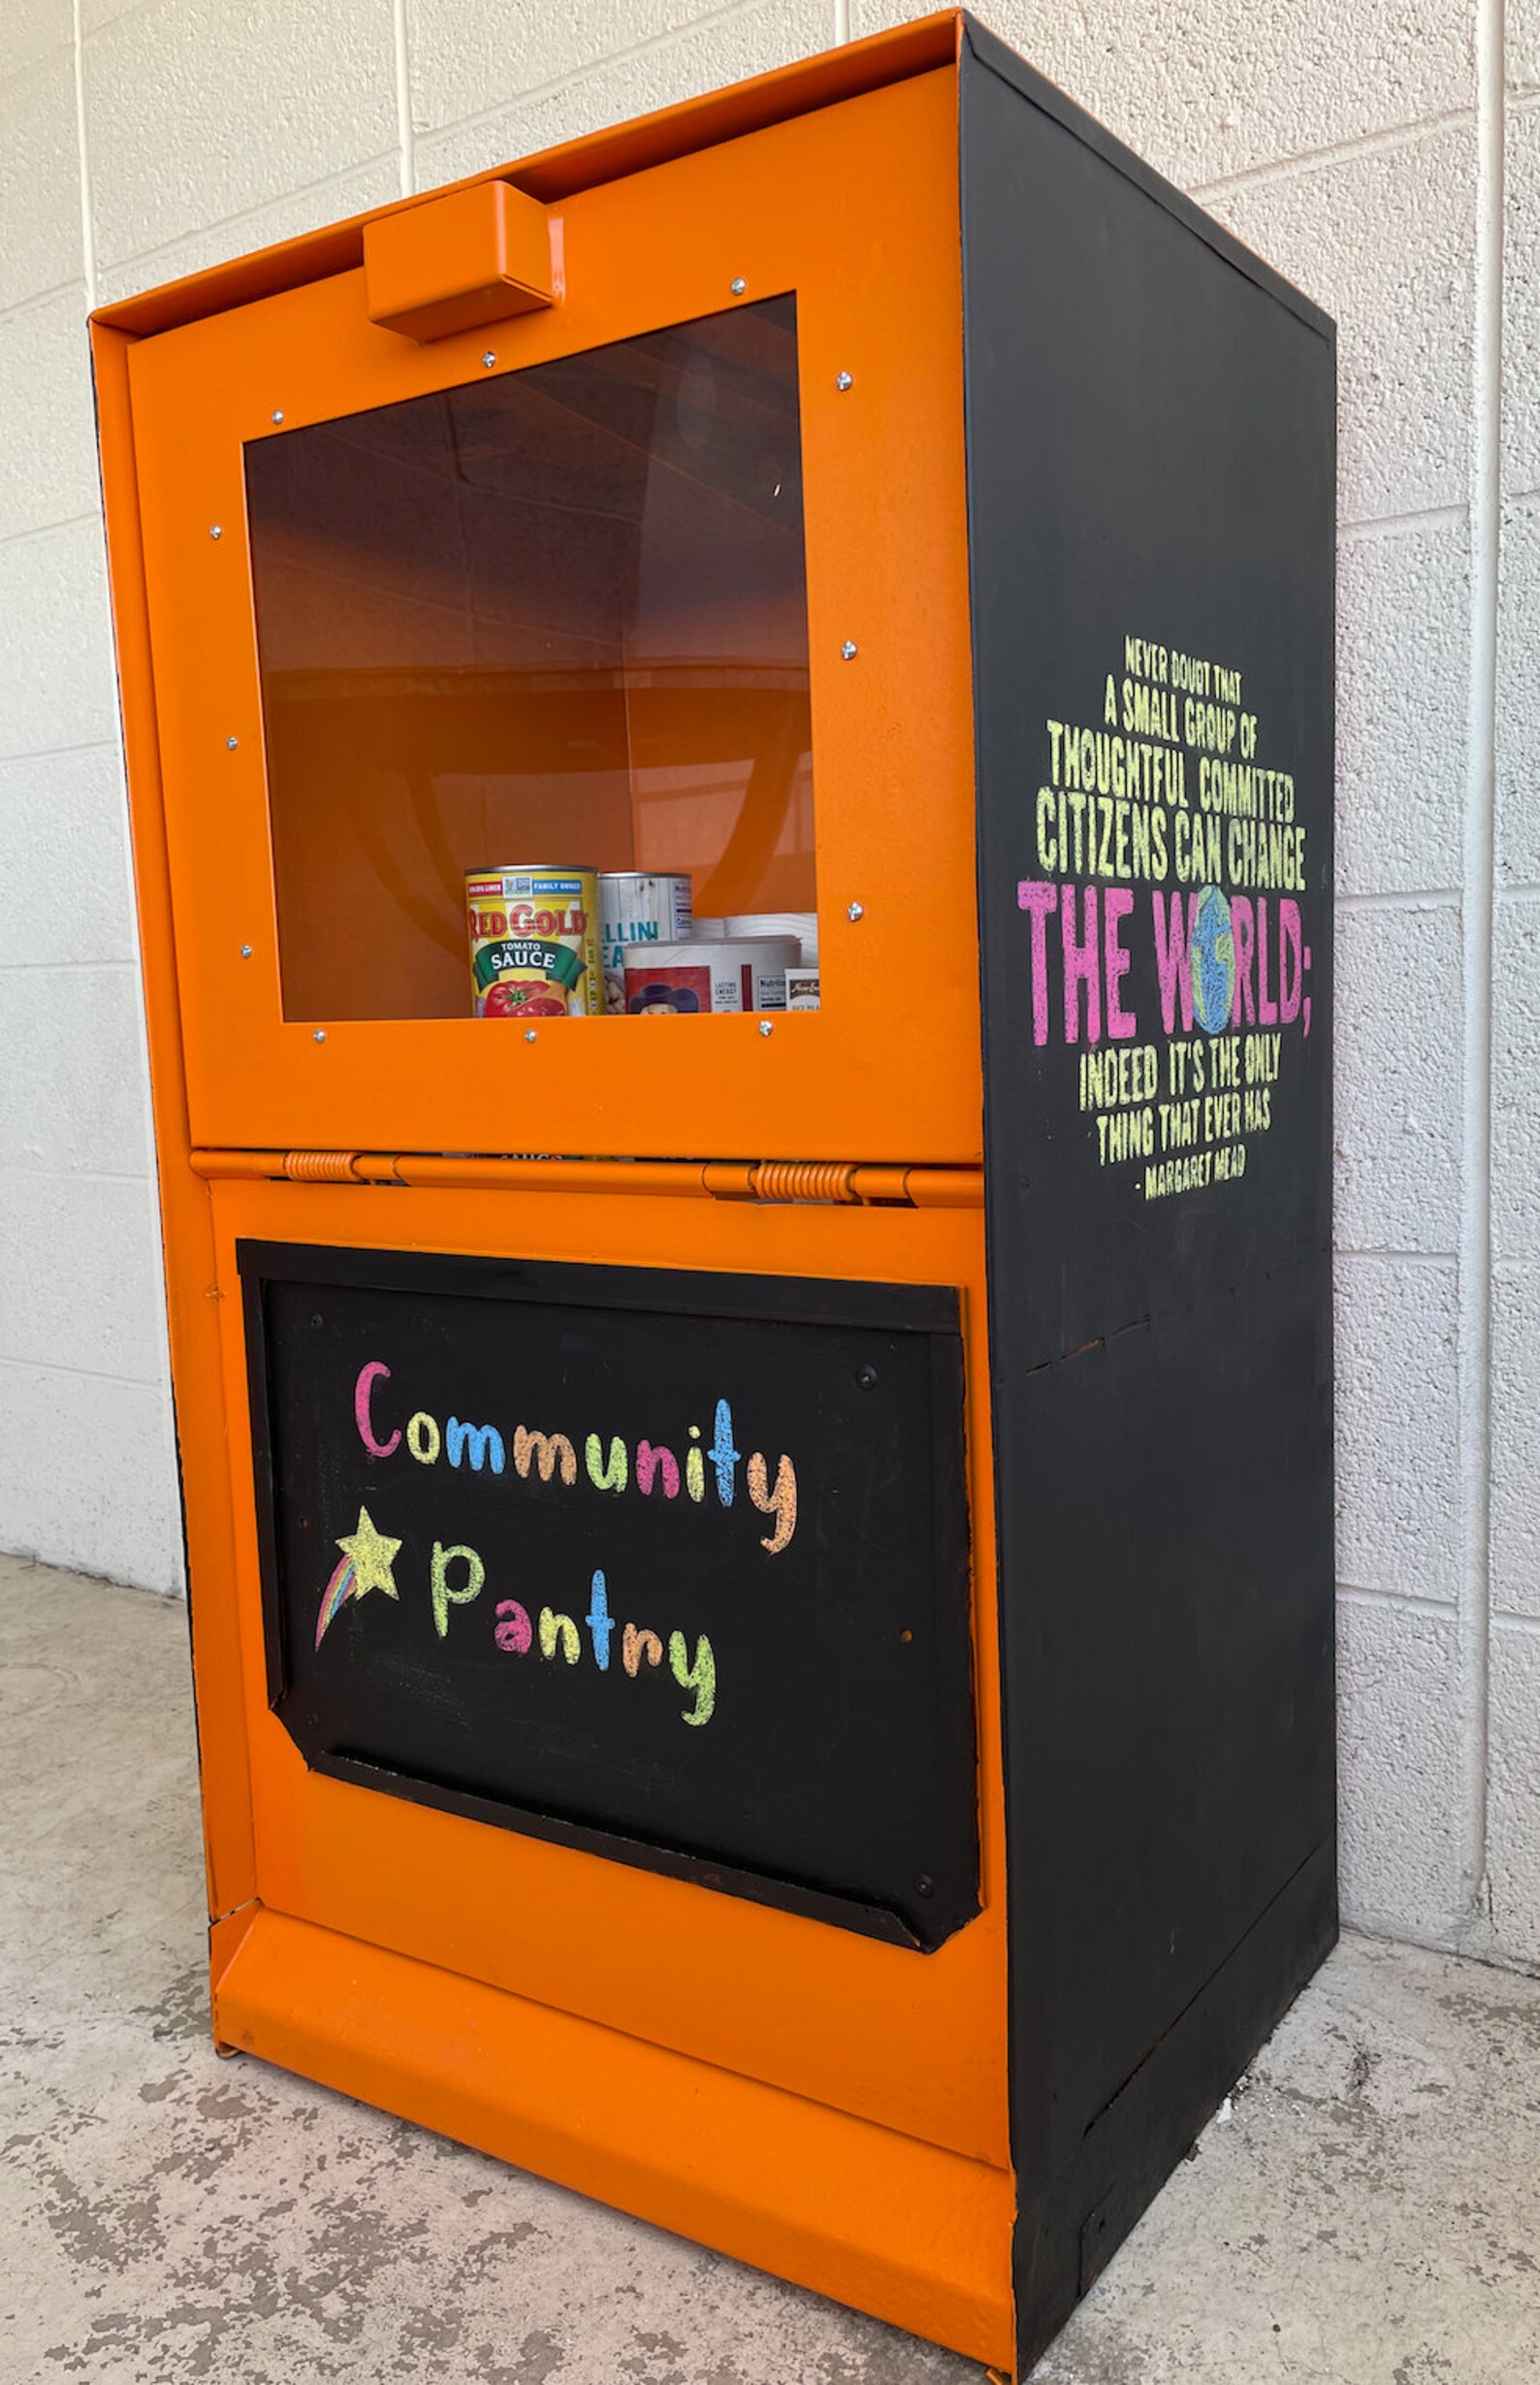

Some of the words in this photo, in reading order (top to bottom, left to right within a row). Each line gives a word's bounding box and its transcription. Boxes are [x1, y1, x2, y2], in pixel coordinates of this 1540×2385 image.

[1124, 634, 1168, 684] NEVER
[1171, 650, 1211, 696] DOUBT
[1213, 664, 1241, 705] THAT
[1104, 674, 1117, 726] A
[1122, 678, 1180, 743] SMALL
[1184, 697, 1236, 754] GROUP
[1239, 712, 1258, 758] OF
[1046, 719, 1189, 808] THOUGHTFUL
[1199, 757, 1294, 823] COMMITTED
[1036, 787, 1169, 882] CITIZENS
[1174, 809, 1222, 884] CAN
[1228, 818, 1306, 891] CHANGE
[510, 903, 588, 937] GOLD
[533, 882, 560, 890] FAMILY
[491, 951, 556, 970] SAUCE
[500, 942, 541, 951] TOMATO
[601, 920, 658, 943] LLINI
[1017, 881, 1137, 1046] THE
[1078, 1045, 1158, 1111] INDEED
[1169, 1038, 1204, 1096] IT'S
[1209, 1035, 1241, 1088] THE
[1244, 1032, 1282, 1084] ONLY
[1096, 1106, 1153, 1166] THING
[1157, 1098, 1201, 1151] THAT
[1203, 1092, 1241, 1143] EVER
[1244, 1088, 1271, 1133] HAS
[1144, 1150, 1212, 1202] MARGARET
[1213, 1144, 1247, 1183] MEAD
[354, 1361, 798, 1555] Community
[430, 1539, 716, 1726] Pantry
